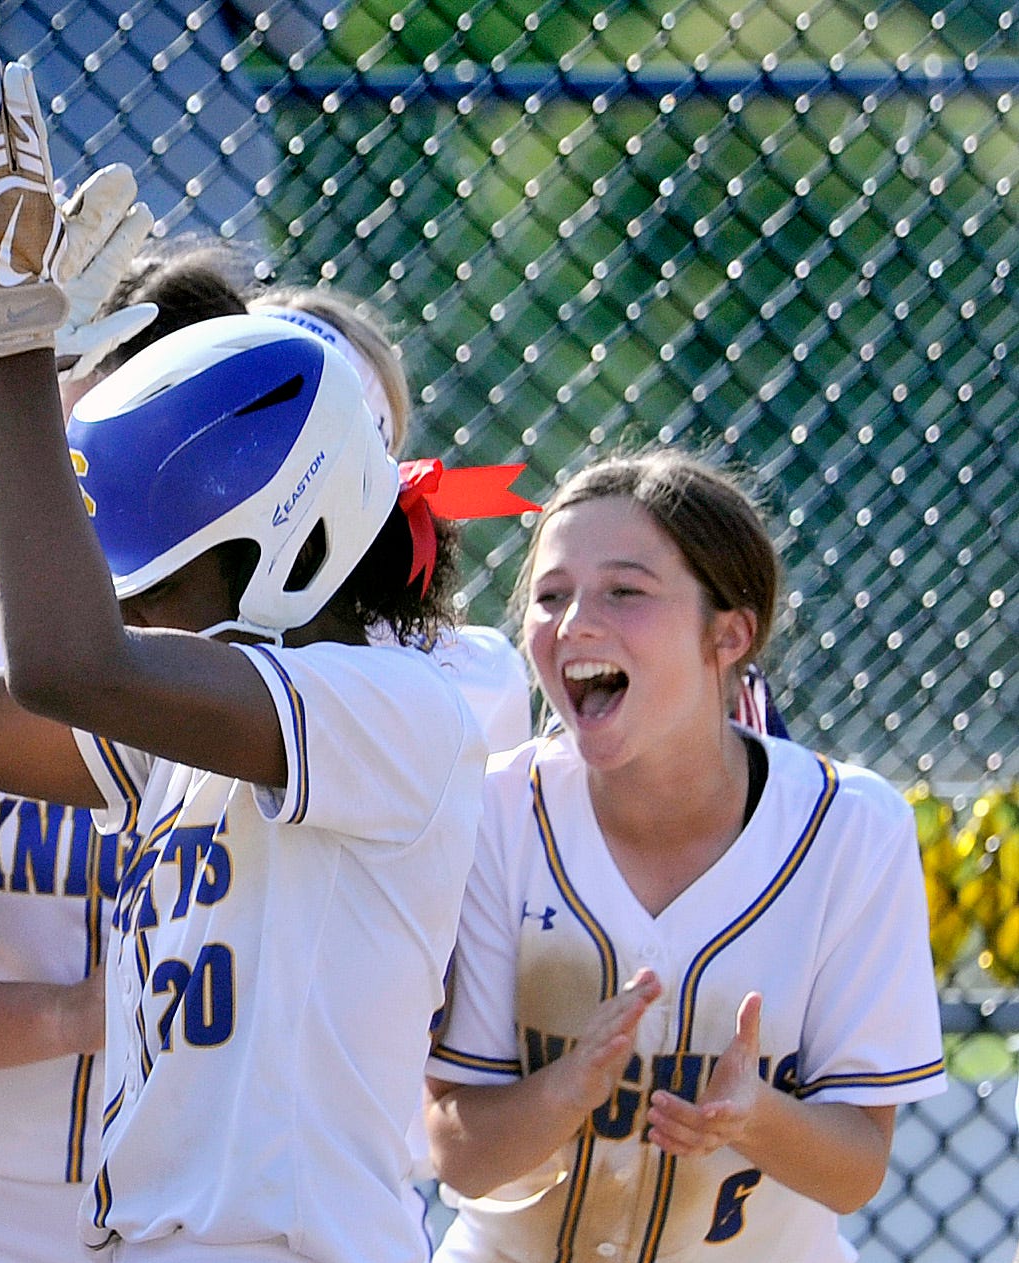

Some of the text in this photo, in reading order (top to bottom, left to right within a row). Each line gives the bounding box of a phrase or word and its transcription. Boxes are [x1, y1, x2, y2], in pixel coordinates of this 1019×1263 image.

[283, 450, 326, 515] EASTON
[151, 941, 236, 1053] 20
[703, 1167, 763, 1246] 6
